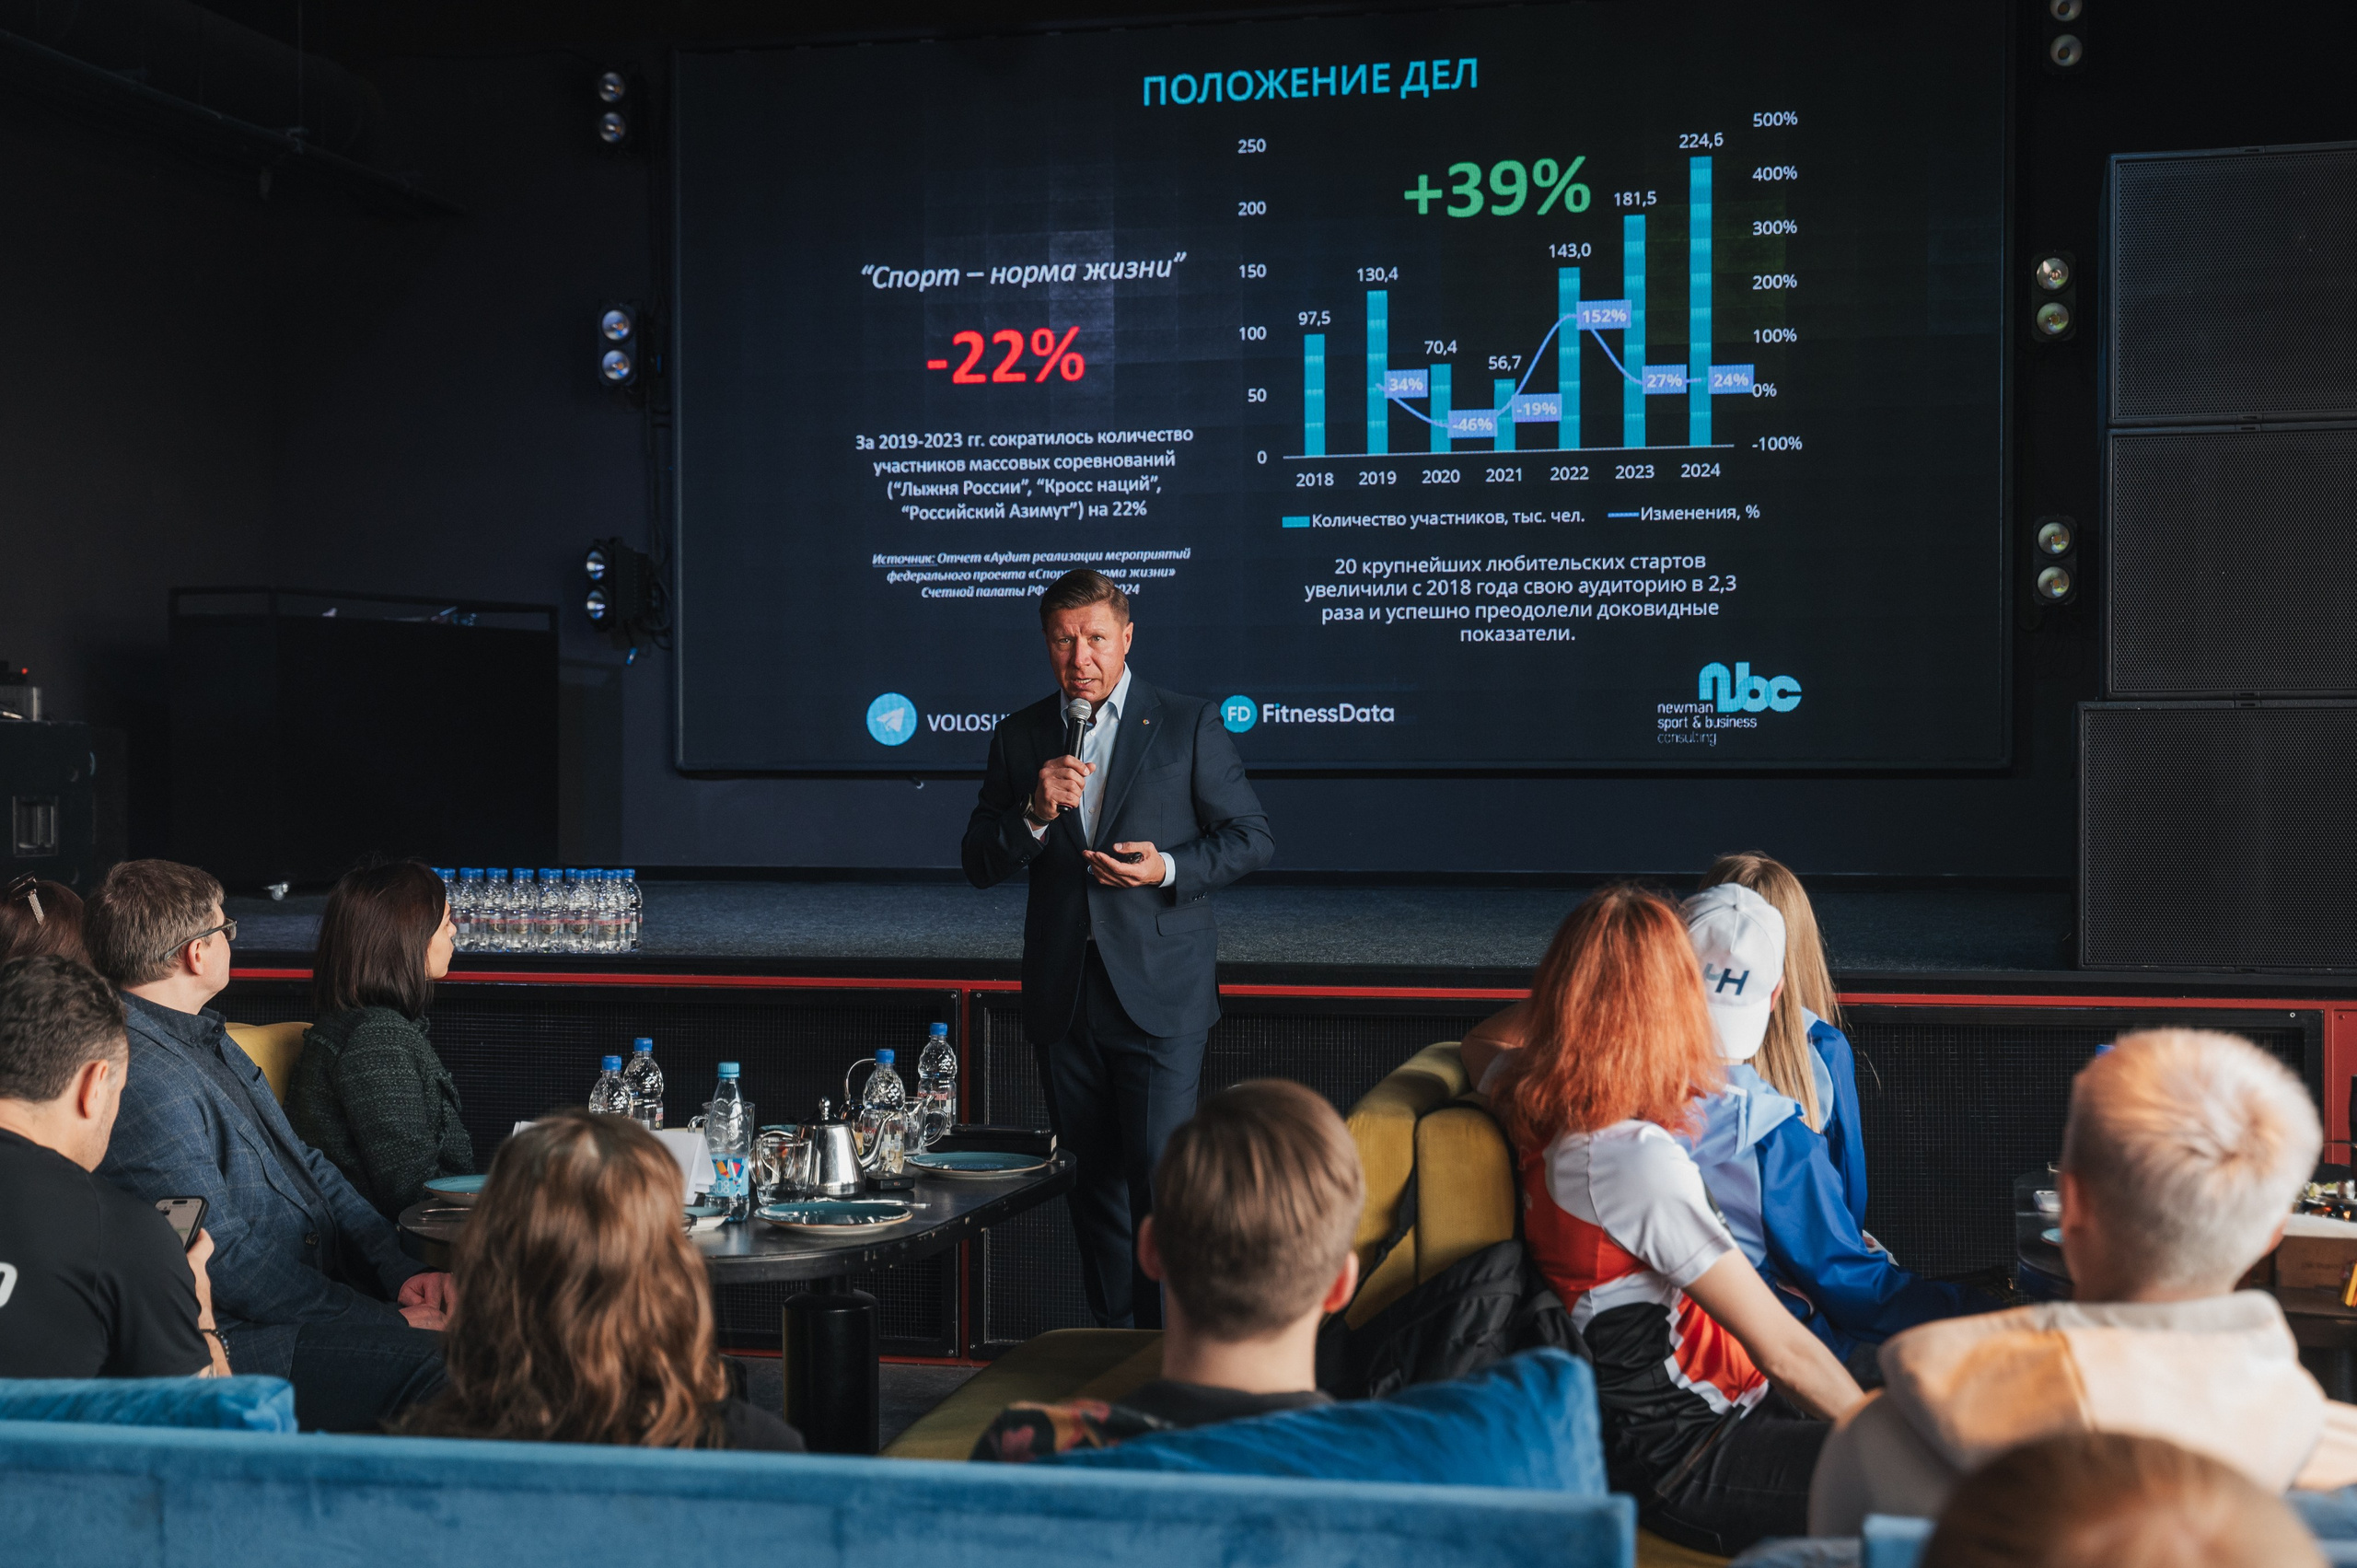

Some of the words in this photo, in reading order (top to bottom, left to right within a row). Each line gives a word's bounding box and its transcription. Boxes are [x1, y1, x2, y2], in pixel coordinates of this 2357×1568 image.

[1144, 63, 1390, 106] ПОЛОЖЕНИЕ
[1400, 58, 1477, 99] ДЕЛ
[1754, 111, 1797, 127] 500%
[1238, 138, 1266, 154] 250
[1679, 133, 1724, 148] 224,6
[1752, 166, 1797, 181] 400%
[1404, 156, 1590, 217] +39%
[1615, 191, 1656, 207] 181,5
[1238, 202, 1266, 215] 200
[1753, 220, 1797, 235] 300%
[1550, 243, 1591, 259] 143,0
[862, 265, 959, 292] “Спорт
[991, 264, 1076, 288] норма
[1083, 251, 1187, 281] жизни”
[1239, 264, 1266, 278] 150
[1357, 267, 1398, 283] 130,4
[1753, 274, 1797, 289] 200%
[1298, 310, 1330, 326] 97,5
[1580, 307, 1628, 324] 152%
[1239, 327, 1267, 341] 100
[1754, 328, 1797, 343] 100%
[927, 326, 1085, 384] -22%
[1424, 340, 1457, 355] 70,4
[1489, 355, 1521, 371] 56,7
[1389, 376, 1424, 392] 34%
[1646, 372, 1682, 389] 27%
[1713, 371, 1750, 389] 24%
[1248, 389, 1267, 402] 50
[1752, 381, 1778, 397] 0%
[1515, 401, 1559, 417] -19%
[1451, 416, 1493, 433] -46%
[856, 436, 875, 449] За
[879, 433, 963, 449] 2019-2023
[968, 436, 984, 447] гг.
[989, 433, 1094, 449] сократилось
[1097, 429, 1193, 443] количество
[1752, 436, 1802, 450] -100%
[874, 460, 966, 476] участников
[970, 458, 1050, 471] массовых
[1054, 449, 1175, 471] соревнований
[1258, 450, 1267, 464] 0
[1296, 472, 1334, 486] 2018
[1359, 470, 1397, 485] 2019
[1422, 470, 1460, 483] 2020
[1486, 468, 1521, 482] 2021
[1550, 466, 1589, 481] 2022
[1616, 465, 1655, 479] 2023
[1681, 463, 1720, 477] 2024
[964, 479, 1031, 496] России”,
[1037, 479, 1093, 495] “Кросс
[1097, 475, 1161, 494] наций”,
[901, 503, 1004, 520] “Российский
[1009, 501, 1084, 520] Азимут”)
[1088, 505, 1108, 517] на
[1113, 500, 1147, 516] 22%
[1642, 506, 1740, 520] Изменения,
[1746, 505, 1759, 518] %
[1313, 514, 1406, 528] Количество
[1411, 513, 1508, 529] участников,
[1513, 512, 1546, 523] тыс.
[1551, 511, 1585, 522] чел.
[872, 553, 935, 565] Источник:
[937, 552, 981, 563] Отчет
[983, 552, 1030, 564] «Аудит
[1032, 552, 1103, 564] реализации
[1105, 548, 1190, 563] мероприятий
[1335, 559, 1356, 574] 20
[1363, 556, 1480, 578] крупнейших
[1486, 555, 1624, 571] любительских
[1631, 556, 1705, 574] стартов
[887, 570, 971, 584] федерального
[973, 571, 1026, 582] проекта
[1028, 567, 1071, 581] «Спор
[1129, 568, 1176, 577] жизни»
[922, 586, 974, 598] Счетной
[976, 587, 1025, 597] палаты
[1114, 583, 1140, 595] 024
[1305, 584, 1407, 602] увеличили
[1412, 584, 1422, 596] с
[1427, 579, 1471, 595] 2018
[1477, 582, 1517, 598] года
[1524, 581, 1573, 594] свою
[1578, 579, 1687, 598] аудиторию
[1692, 579, 1702, 591] в
[1709, 575, 1736, 593] 2,3
[1322, 608, 1364, 625] раза
[1370, 608, 1380, 620] и
[1386, 606, 1469, 624] успешно
[1476, 604, 1592, 622] преодолели
[1596, 603, 1719, 620] доковидные
[1461, 629, 1575, 642] показатели.
[1227, 705, 1250, 723] FD
[1263, 703, 1394, 723] FitnessData
[1657, 703, 1713, 714] newman
[926, 713, 1011, 733] VOLOSH
[1658, 716, 1688, 731] sport
[1692, 715, 1701, 728] &
[1705, 715, 1757, 728] business
